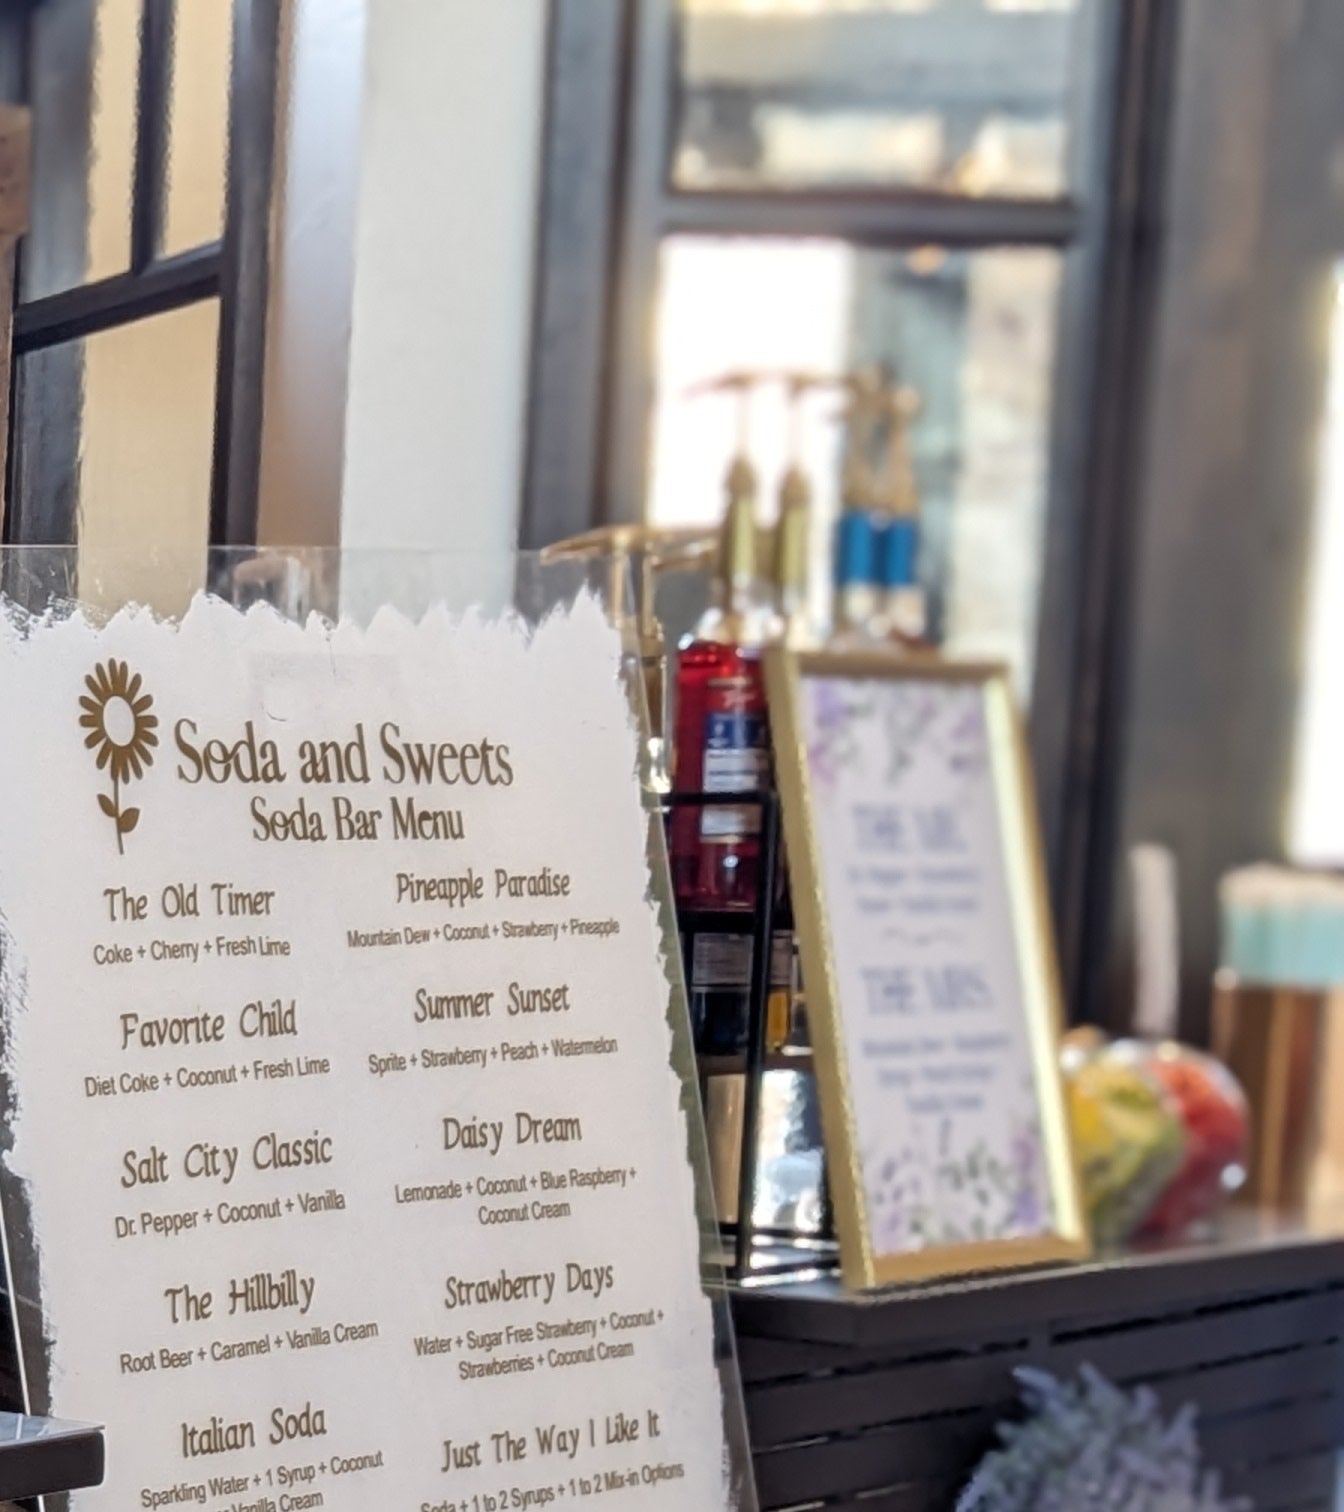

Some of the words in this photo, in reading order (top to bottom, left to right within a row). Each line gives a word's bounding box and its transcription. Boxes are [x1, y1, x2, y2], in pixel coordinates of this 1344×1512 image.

[174, 718, 286, 784] Soda
[298, 723, 371, 784] and
[380, 722, 513, 786] Sweets
[250, 796, 327, 842] Soda
[332, 796, 382, 840] Bar
[390, 796, 464, 840] Menu
[104, 886, 148, 922] The
[162, 883, 200, 918] Old
[210, 883, 275, 916] Timer
[396, 868, 483, 908] Pineapple
[495, 867, 570, 898] Paradise
[94, 944, 132, 965] Coke
[150, 940, 199, 963] Cherry
[216, 936, 257, 956] Fresh
[258, 936, 290, 956] Lime
[347, 928, 402, 948] Mountain
[404, 927, 430, 945] Dew
[443, 924, 490, 942] Coconut
[502, 921, 558, 941] Strawberry
[570, 918, 620, 938] Pineapple
[120, 1013, 224, 1050] Favorite
[239, 1000, 297, 1038] Child
[414, 991, 494, 1023] Summer
[507, 984, 570, 1016] Sunset
[84, 1076, 117, 1097] Diet
[120, 1072, 159, 1094] Coke
[176, 1065, 238, 1088] Coconut
[253, 1058, 294, 1080] Fresh
[296, 1056, 330, 1076] Lime
[368, 1053, 406, 1078] Sprite
[421, 1047, 487, 1068] Strawberry
[501, 1041, 539, 1061] Peach
[551, 1036, 618, 1057] Watermelon
[442, 1116, 503, 1156] Daisy
[515, 1112, 582, 1144] Dream
[121, 1149, 169, 1188] Salt
[184, 1143, 238, 1184] City
[253, 1130, 332, 1170] Classic
[395, 1180, 462, 1203] Lemonade
[476, 1175, 528, 1196] Coconut
[540, 1172, 567, 1190] Blue
[569, 1168, 626, 1190] Raspberry
[115, 1216, 137, 1238] Dr.
[140, 1212, 198, 1237] Pepper
[217, 1198, 282, 1224] Coconut
[297, 1190, 346, 1214] Vanilla
[478, 1204, 530, 1225] Coconut
[531, 1201, 571, 1220] Cream
[165, 1284, 212, 1324] The
[228, 1270, 314, 1315] Hillbilly
[445, 1271, 555, 1309] Strawberry
[566, 1263, 613, 1298] Days
[120, 1352, 156, 1374] Root
[159, 1348, 194, 1368] Beer
[210, 1334, 270, 1361] Caramel
[286, 1327, 331, 1349] Vanilla
[334, 1323, 378, 1343] Cream
[414, 1336, 452, 1356] Water
[466, 1330, 503, 1352] Sugar
[505, 1325, 534, 1344] Free
[536, 1319, 597, 1340] Strawberry
[610, 1309, 656, 1330] Coconut
[458, 1354, 534, 1380] Strawberries
[547, 1345, 596, 1368] Coconut
[597, 1342, 634, 1360] Cream
[182, 1417, 255, 1458] Italian
[269, 1403, 327, 1445] Soda
[441, 1440, 482, 1472] Just
[490, 1430, 526, 1463] The
[535, 1424, 579, 1459] Way
[589, 1419, 595, 1447] I
[606, 1413, 638, 1444] Like
[648, 1410, 660, 1438] It
[141, 1483, 206, 1511] Sparkling
[208, 1476, 249, 1496] Water
[266, 1469, 273, 1486] 1
[277, 1465, 315, 1488] Syrup
[330, 1450, 384, 1475] Coconut
[279, 1492, 323, 1512] Cream
[483, 1494, 497, 1512] to
[499, 1490, 508, 1510] 2
[511, 1487, 555, 1512] Syrups
[569, 1479, 576, 1496] 1
[579, 1478, 591, 1496] to
[594, 1474, 602, 1494] 2
[642, 1464, 684, 1486] Options
